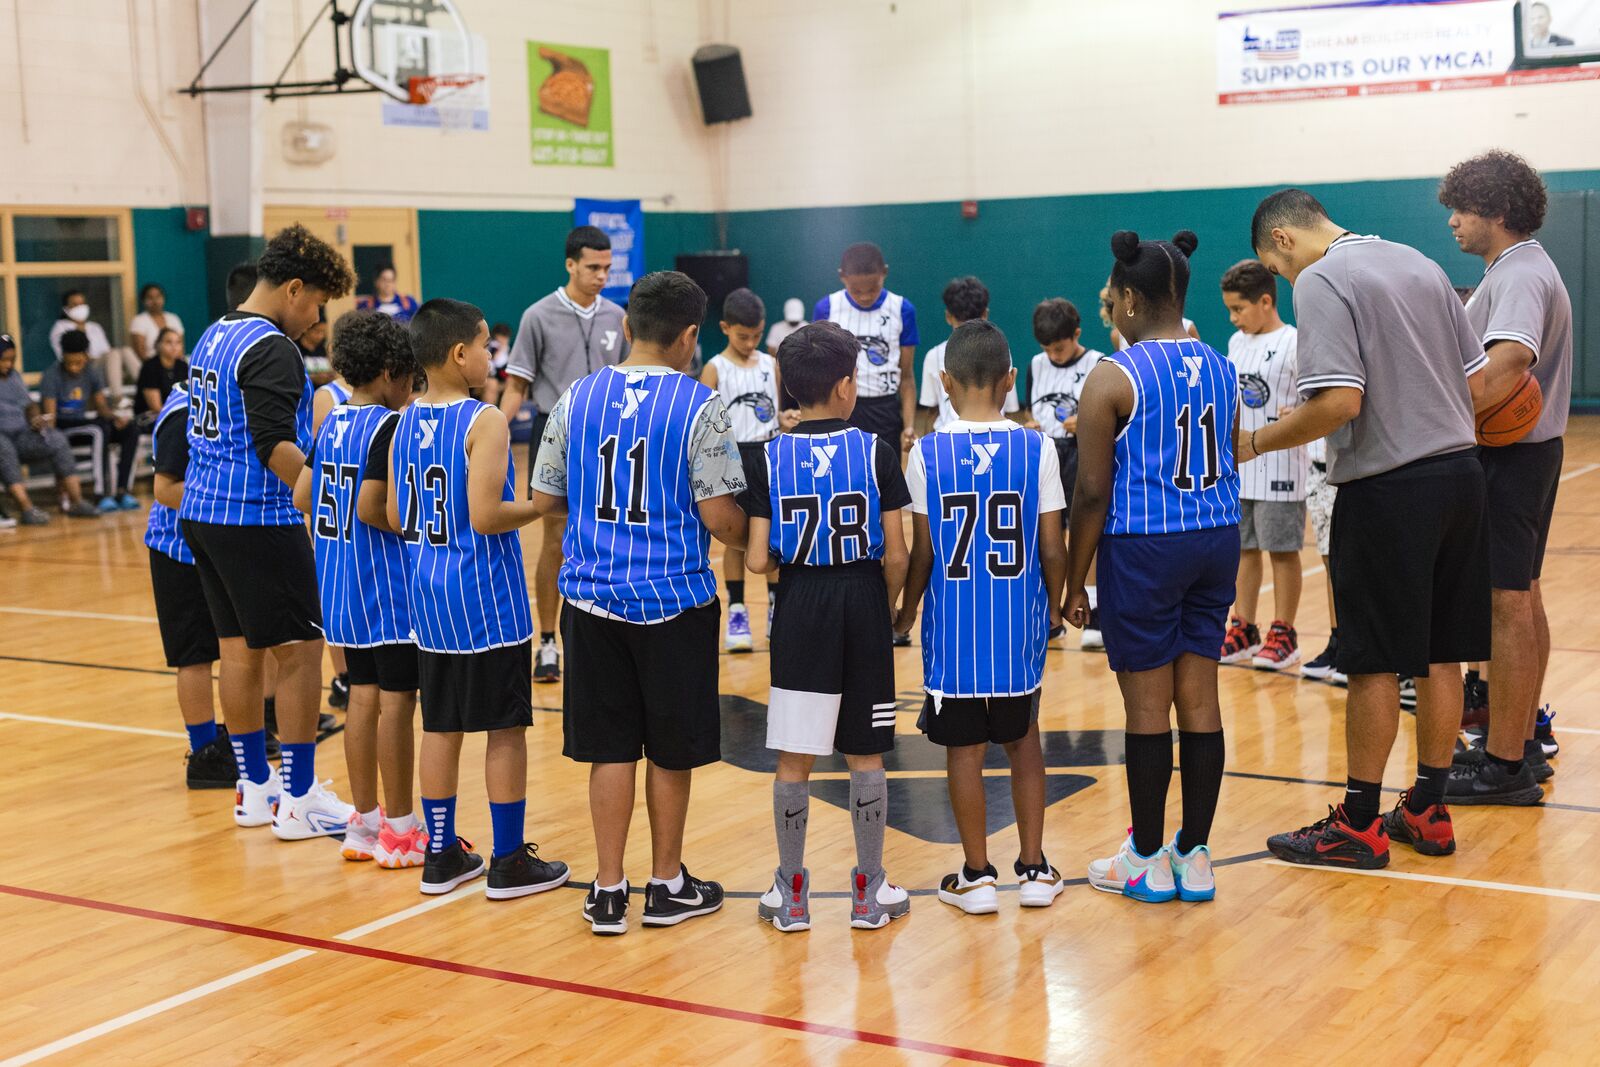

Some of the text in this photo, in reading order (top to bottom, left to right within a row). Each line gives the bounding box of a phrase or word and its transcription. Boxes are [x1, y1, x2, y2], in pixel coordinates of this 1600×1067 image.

[1241, 50, 1493, 84] SUPPORTS OUR YMCA!
[189, 366, 221, 442] 56
[611, 401, 624, 409] the
[879, 371, 898, 393] 35
[801, 460, 814, 468] the
[961, 457, 974, 466] the
[1172, 403, 1221, 492] 11
[316, 461, 359, 544] 57
[402, 463, 450, 546] 13
[595, 434, 649, 525] 11
[780, 491, 870, 566] 78
[941, 491, 1025, 580] 79
[856, 810, 881, 822] FLY
[790, 906, 804, 917] 23
